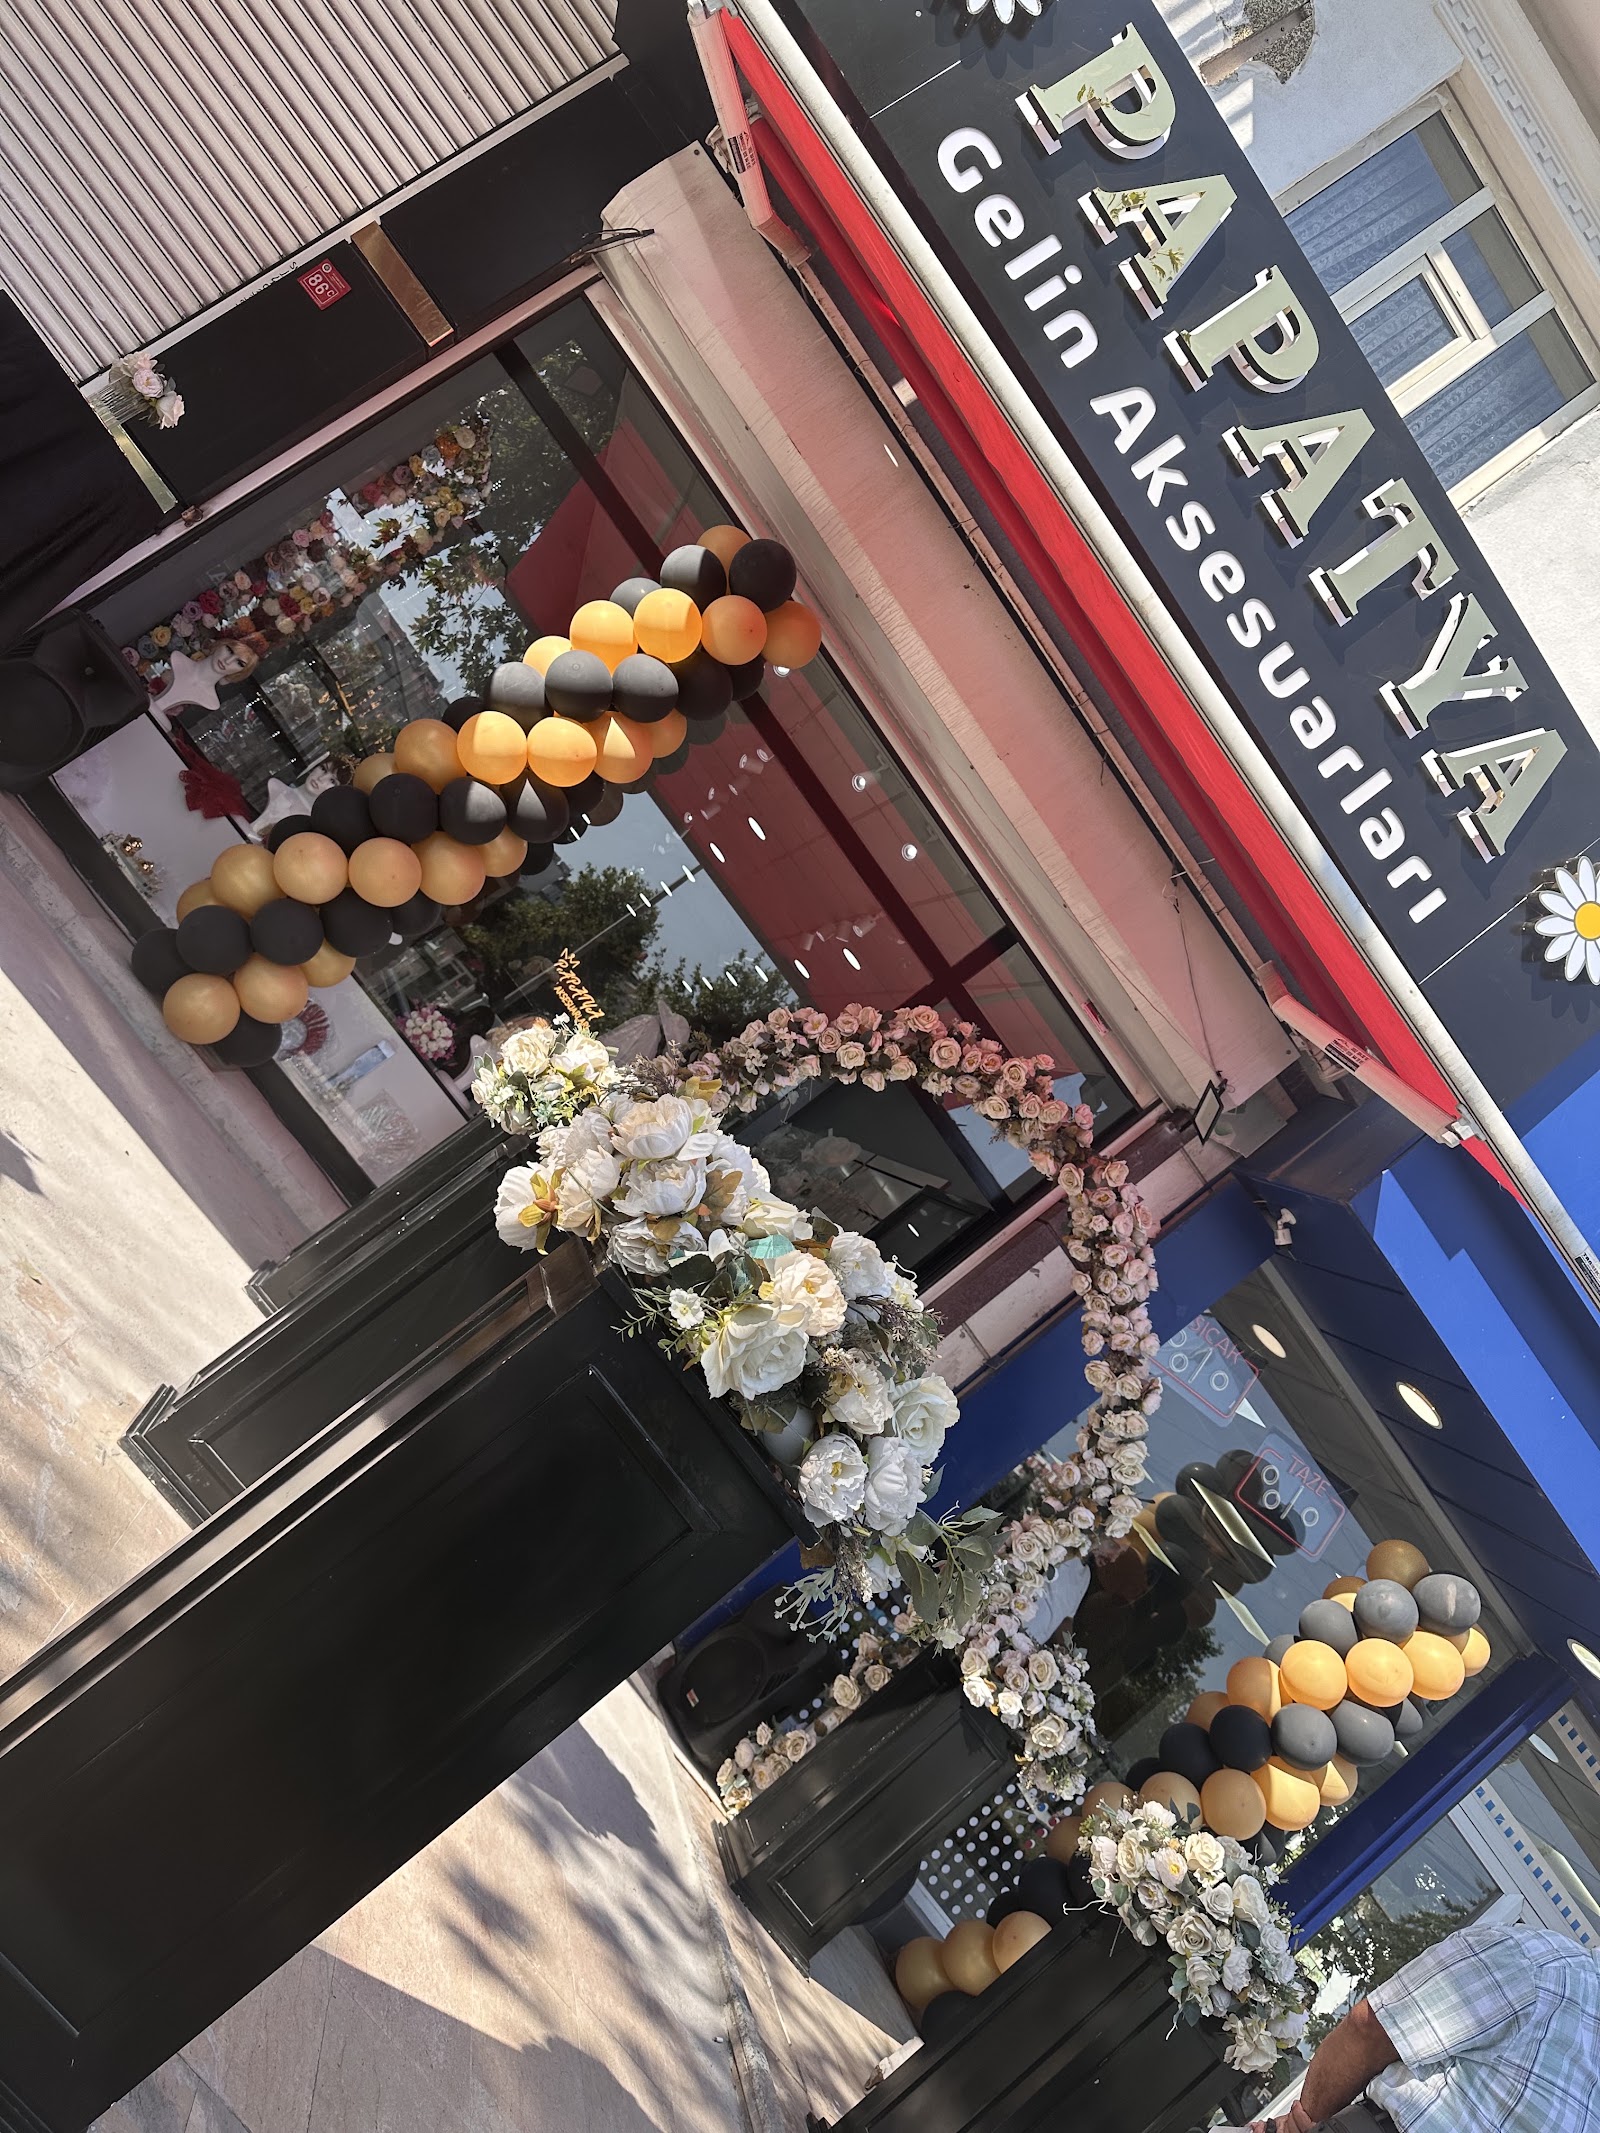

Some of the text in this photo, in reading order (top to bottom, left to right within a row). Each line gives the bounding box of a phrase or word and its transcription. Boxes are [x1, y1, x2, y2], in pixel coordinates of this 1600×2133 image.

[937, 126, 1447, 924] Gelin Aksesuarları
[1014, 22, 1568, 863] PAPATYA
[553, 959, 606, 1022] PAPATYA
[1288, 1454, 1331, 1498] TAZE
